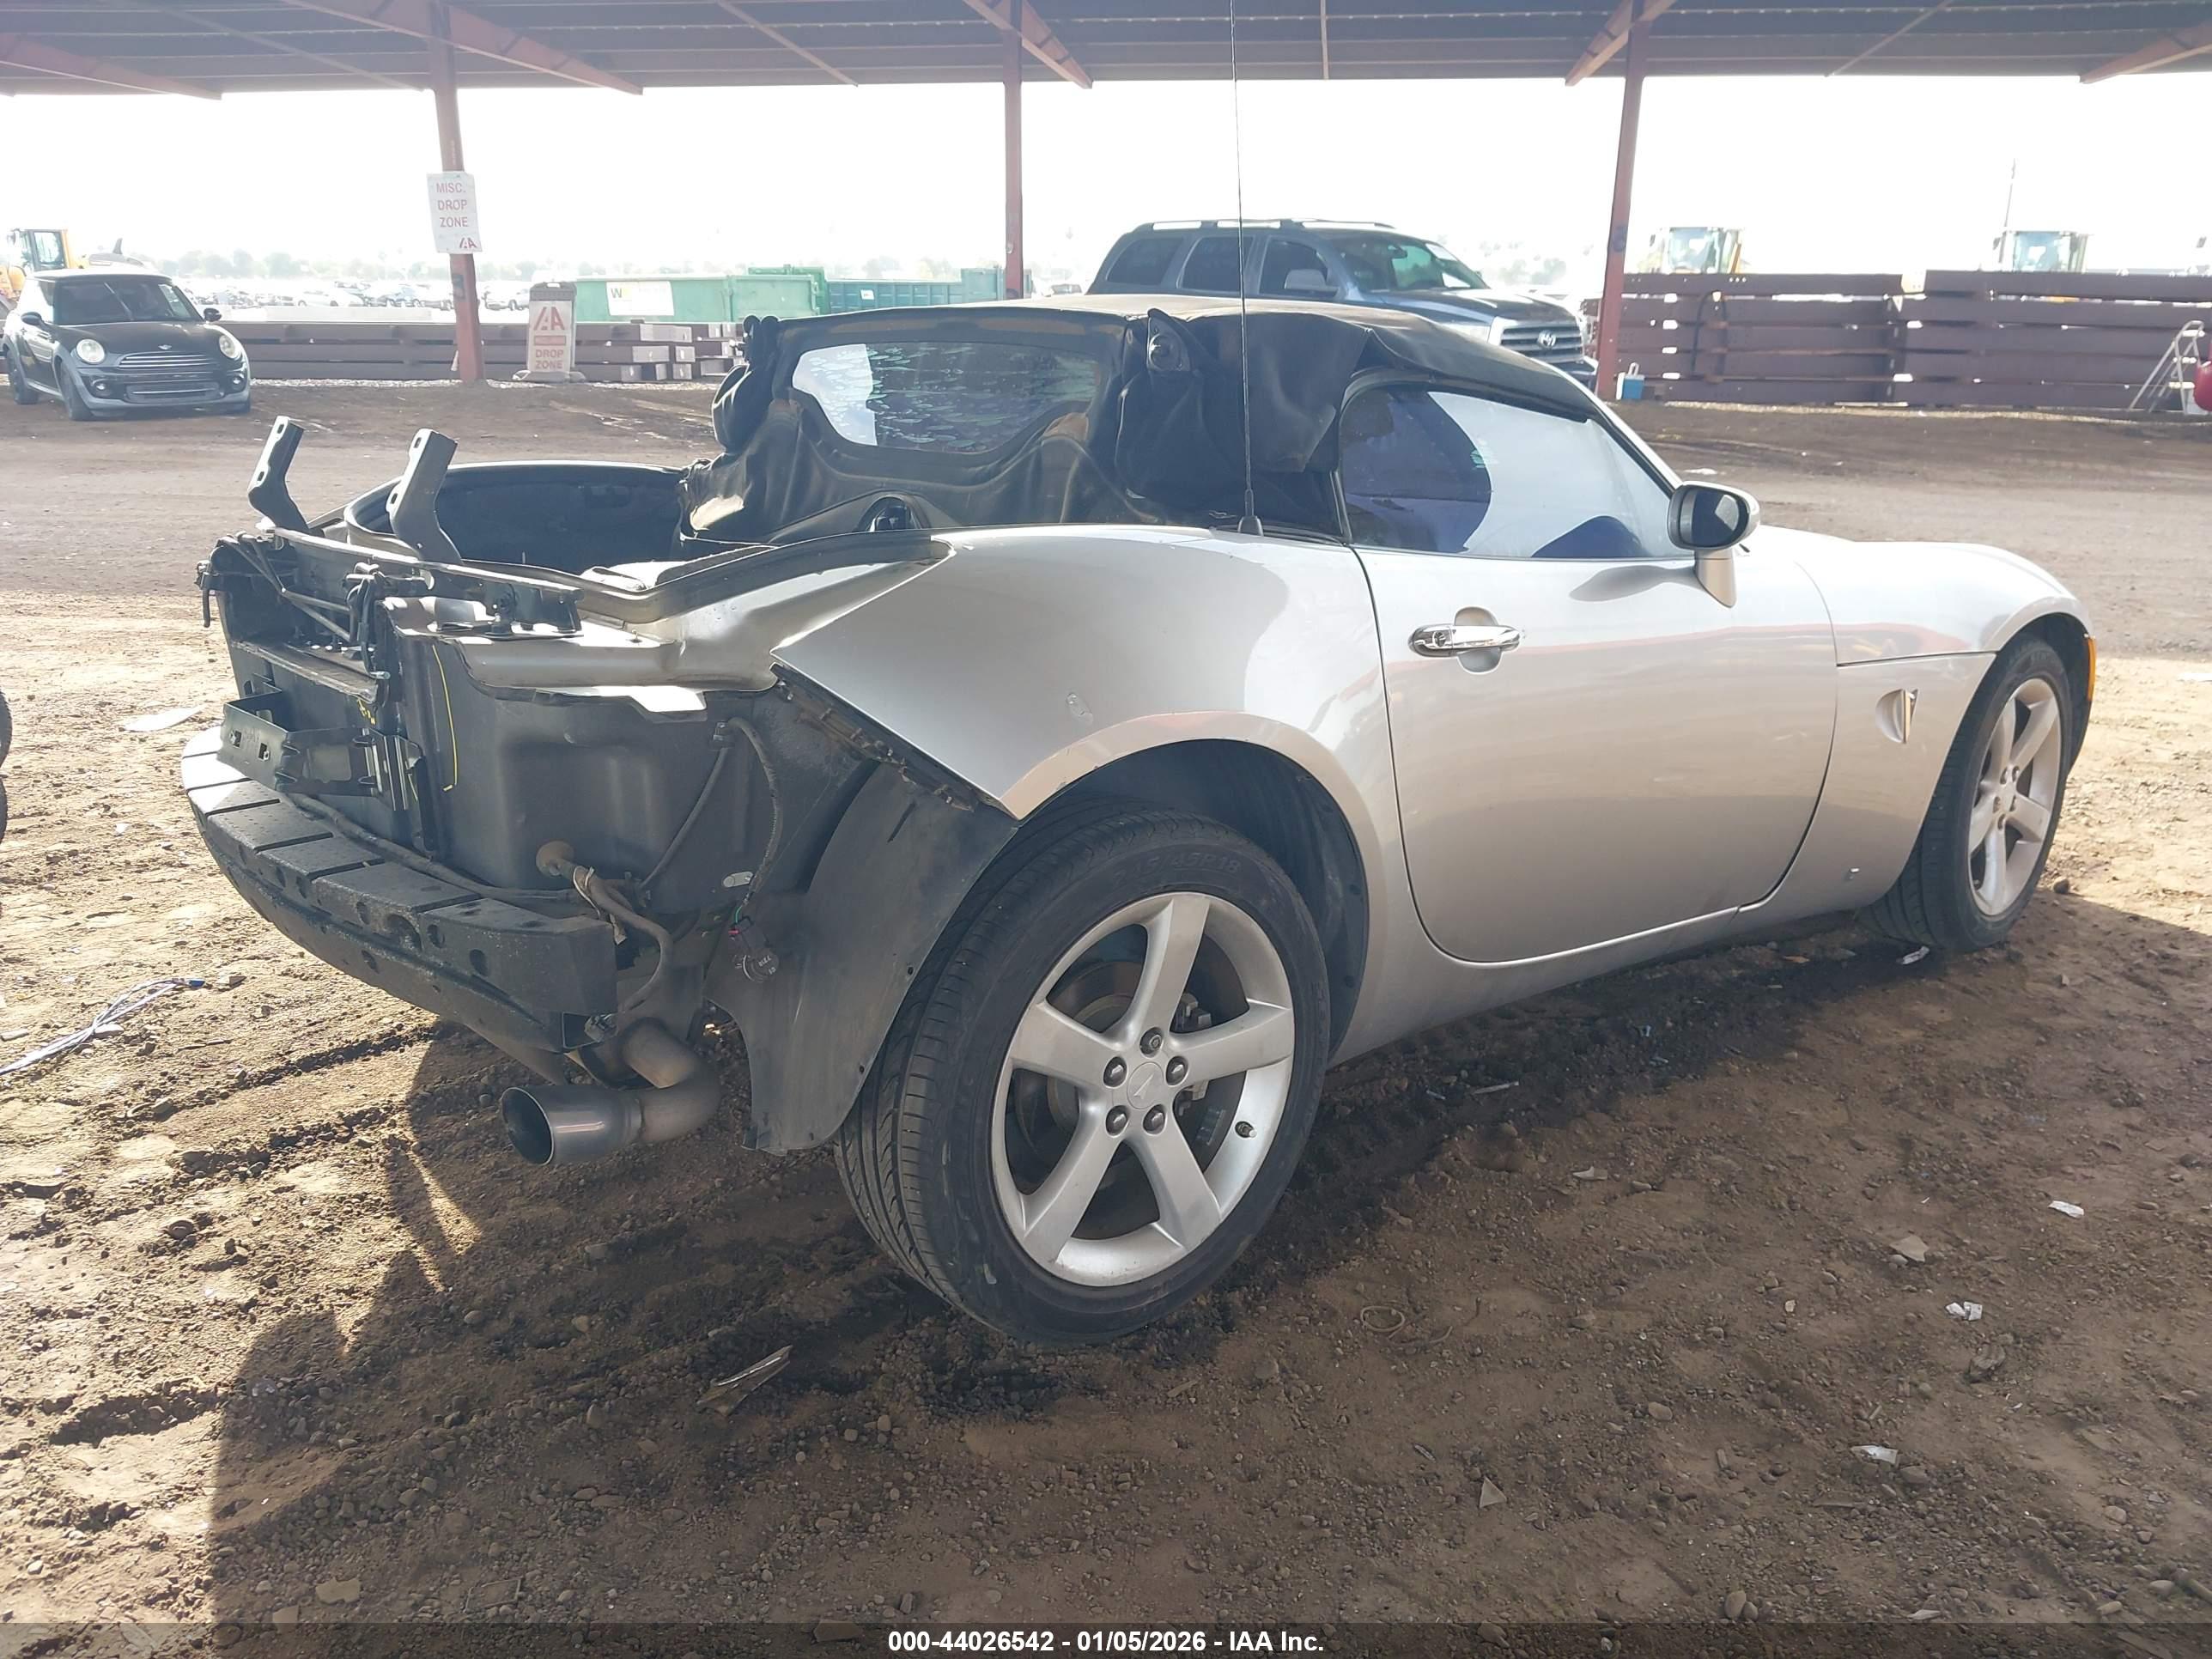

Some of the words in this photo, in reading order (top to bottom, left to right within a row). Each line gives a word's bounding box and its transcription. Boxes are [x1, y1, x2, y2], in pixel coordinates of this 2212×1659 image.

[436, 183, 466, 193] MISC.
[437, 199, 468, 210] DROP
[439, 216, 468, 228] ZONE
[535, 349, 564, 358] DROP
[535, 360, 563, 369] ZONE
